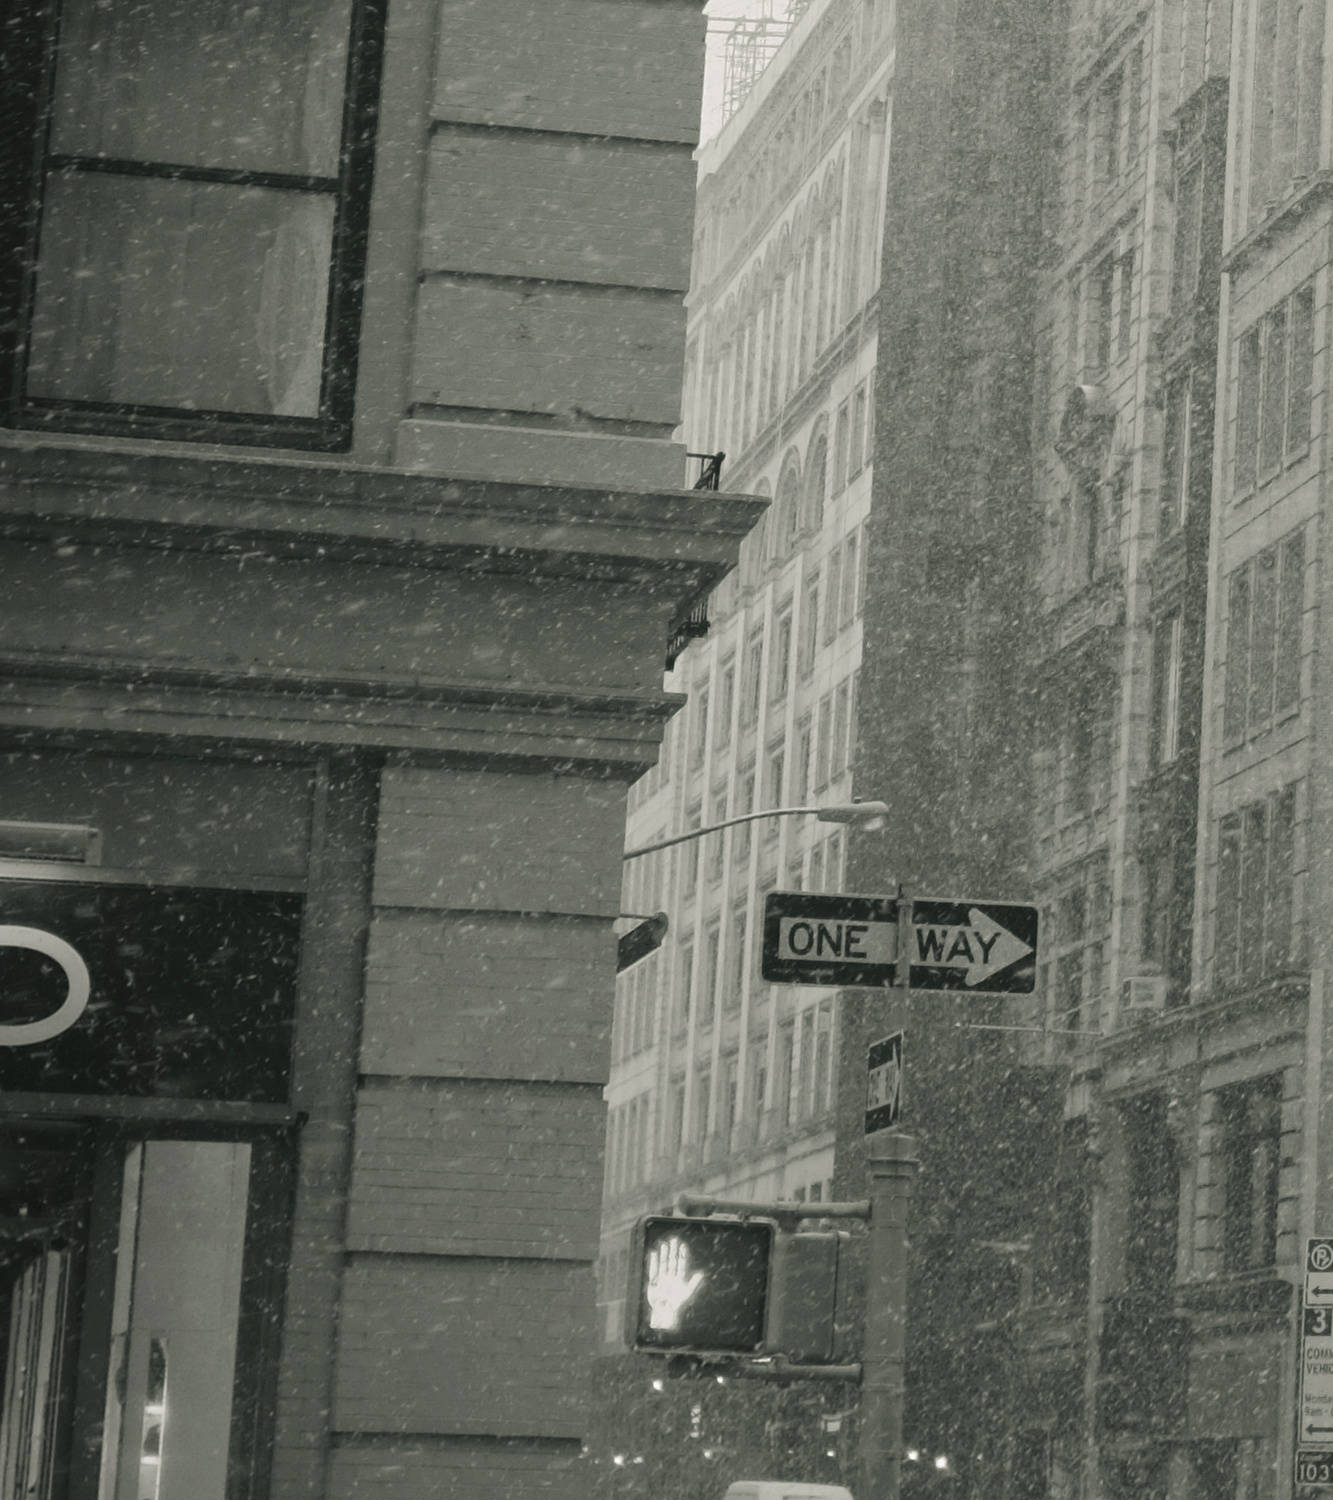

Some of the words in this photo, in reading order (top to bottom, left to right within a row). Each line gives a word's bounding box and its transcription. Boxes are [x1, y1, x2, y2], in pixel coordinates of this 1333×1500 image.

[787, 921, 869, 960] ONE
[915, 927, 1001, 966] WAY
[1311, 1308, 1327, 1334] 3
